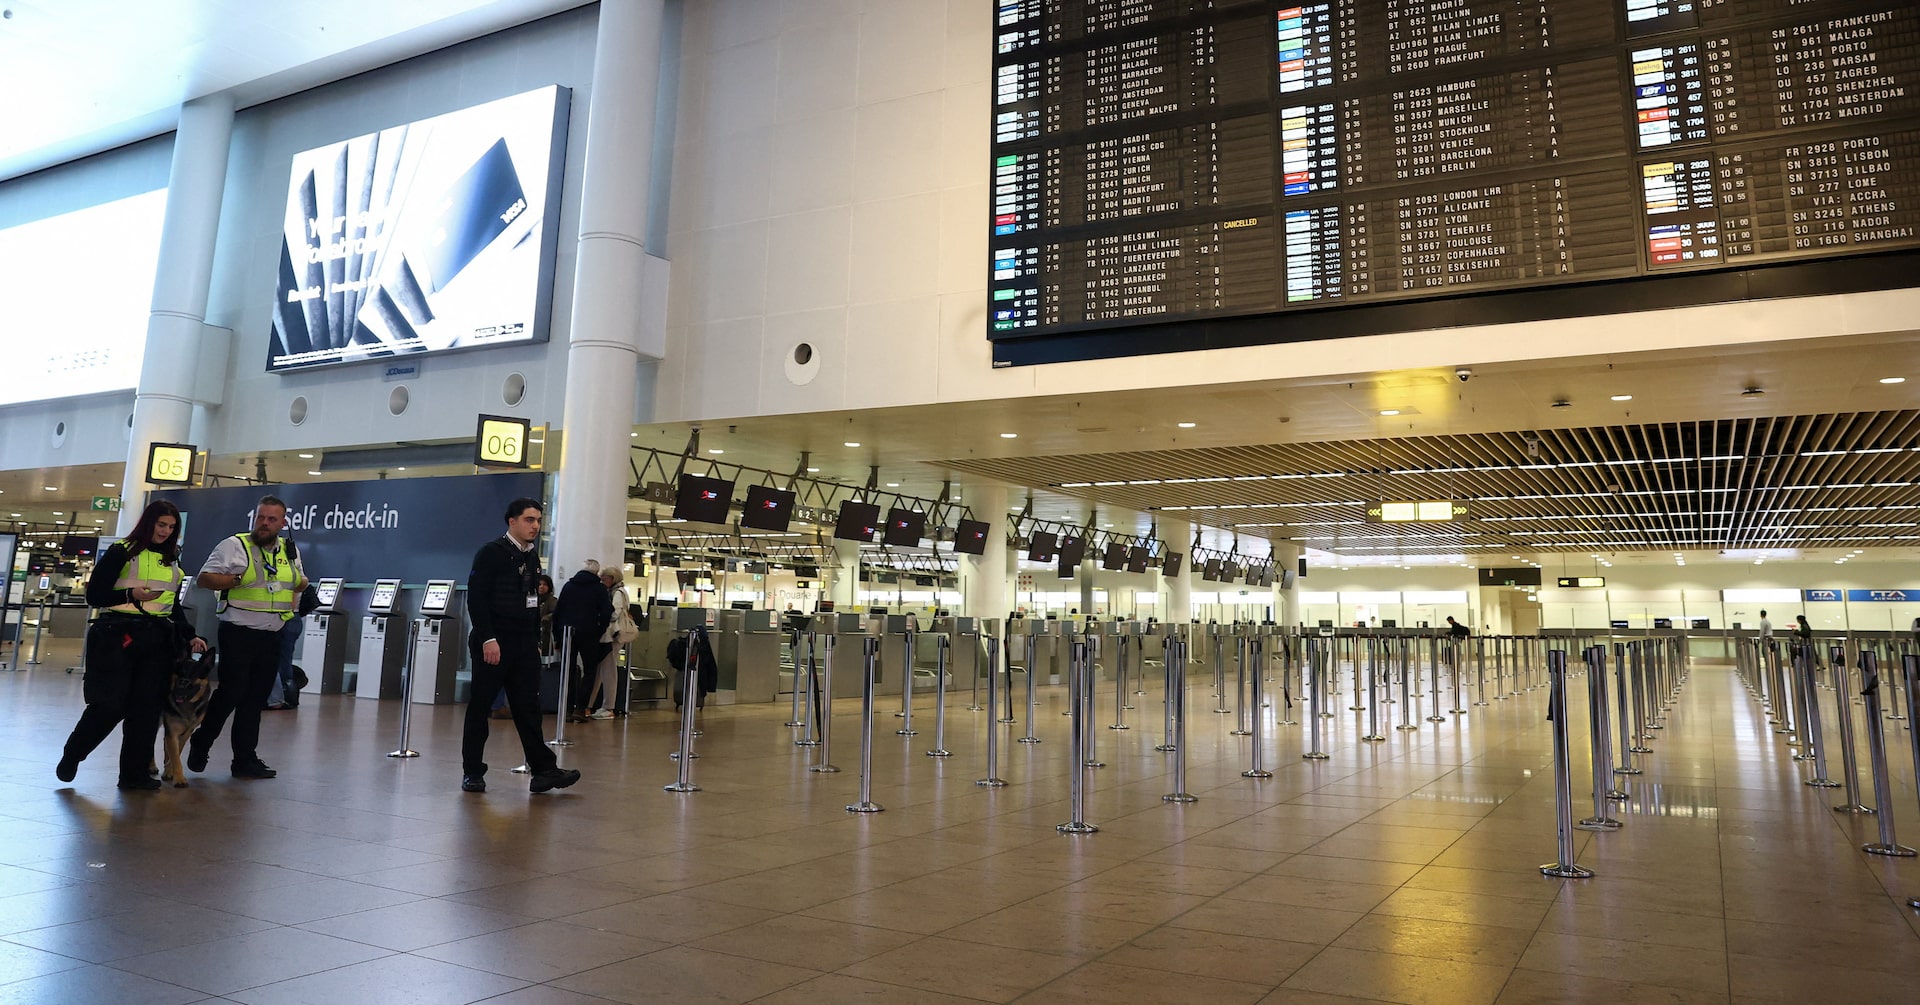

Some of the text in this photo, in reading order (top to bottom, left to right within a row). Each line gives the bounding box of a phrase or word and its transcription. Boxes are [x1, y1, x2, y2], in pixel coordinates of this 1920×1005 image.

[1430, 0, 1464, 11] MADRID
[1388, 22, 1399, 30] BT
[1432, 9, 1470, 22] TALLINN
[1389, 32, 1399, 40] AZ
[1432, 22, 1460, 33] MILAN
[1466, 14, 1500, 27] LINATE
[1772, 12, 1892, 39] SN 2611 FRANKFURT
[1433, 32, 1461, 43] MILAN
[1467, 26, 1501, 38] LINATE
[1773, 28, 1873, 51] VY 961 MALAGA
[1434, 43, 1467, 55] PRAGUE
[1775, 41, 1867, 63] SN 3811 PORTO
[1435, 51, 1485, 65] FRANKFURT
[1804, 61, 1825, 71] 236
[1832, 53, 1876, 67] WARSAW
[1806, 73, 1826, 83] 457
[1834, 66, 1878, 80] ZAGREB
[1436, 80, 1476, 93] HAMBURG
[1779, 76, 1895, 100] HU 760 SHENZHEN
[1394, 103, 1405, 111] FR
[1437, 93, 1471, 104] MALAGA
[1438, 101, 1488, 115] MARSEILLE
[1780, 88, 1904, 113] KL 1704 AMSTERDAM
[1438, 115, 1473, 127] MUNICH
[1782, 104, 1883, 126] UX 1172 MADRID
[1439, 124, 1491, 138] STOCKHOLM
[1440, 138, 1474, 149] VENICE
[1786, 137, 1879, 157] FR 2928 PORTO
[1396, 159, 1407, 167] VY
[1441, 161, 1476, 172] BERLIN
[1787, 149, 1889, 170] SN 3815 LISBON
[1789, 162, 1891, 183] SN 3713 BILBAO
[1444, 190, 1478, 201] LONDON
[1484, 187, 1501, 196] LHR
[1790, 177, 1877, 195] SN 277 LOME
[1444, 200, 1490, 212] ALICANTE
[1813, 190, 1886, 206] VIA: ACCRA
[1445, 215, 1468, 224] LYON
[1793, 202, 1895, 221] SN 3245 ATHENS
[1223, 218, 1258, 229] CANCELLED
[1446, 224, 1492, 236] TENERIFE
[1824, 221, 1845, 231] 116
[1852, 216, 1890, 228] NADOR
[1401, 245, 1412, 253] SN
[1446, 235, 1492, 248] TOULOUSE
[1818, 234, 1846, 245] 1660
[1854, 228, 1913, 241] SHANGHAI
[1402, 257, 1413, 265] SN
[1447, 246, 1505, 260] COPENHAGEN
[1448, 259, 1500, 272] ESKISEHIR
[1403, 280, 1414, 288] BT
[1448, 274, 1472, 283] RIGA
[487, 434, 516, 457] 06
[158, 459, 184, 477] 05
[323, 502, 399, 530] check-in
